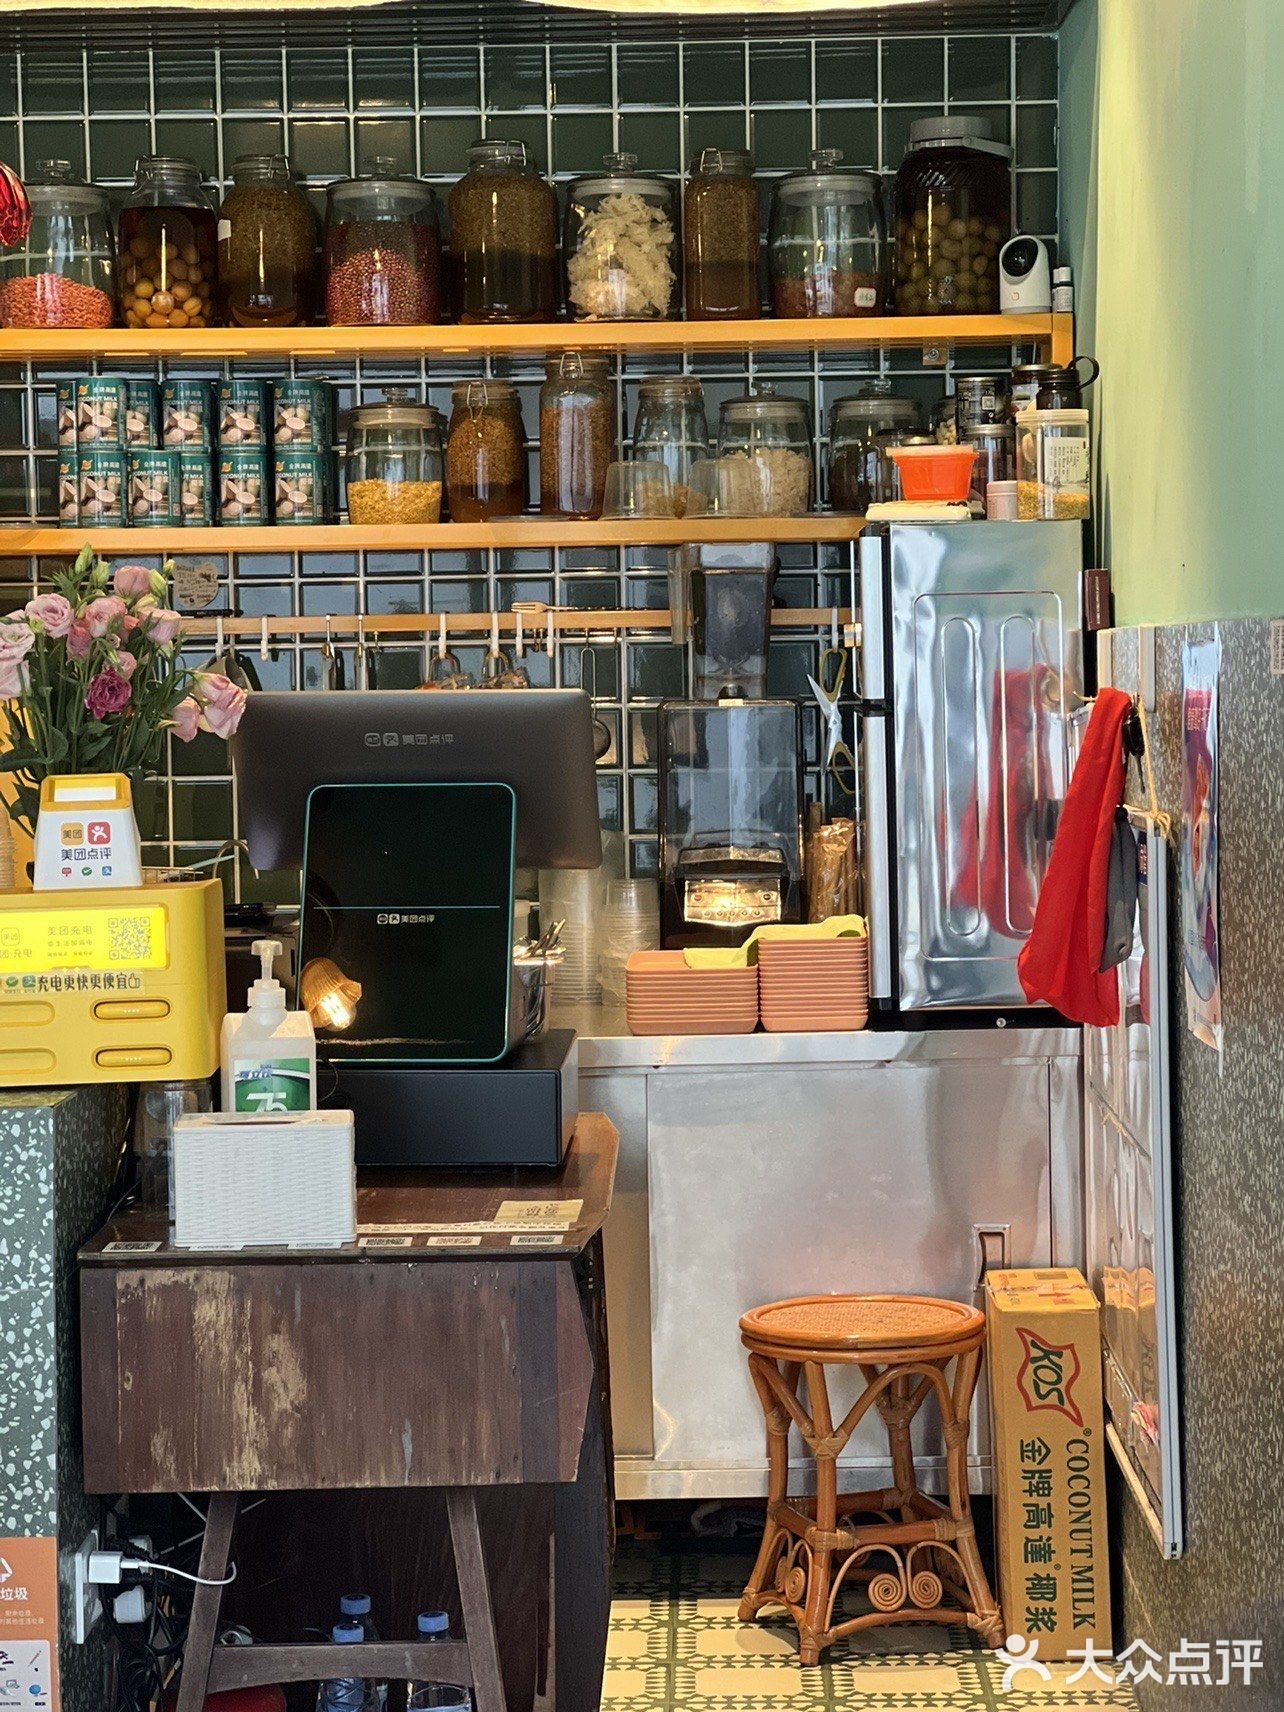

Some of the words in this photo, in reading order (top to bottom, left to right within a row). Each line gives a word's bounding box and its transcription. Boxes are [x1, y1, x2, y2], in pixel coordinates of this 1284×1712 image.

[61, 847, 112, 861] 美团点评
[48, 925, 93, 936] 美团充电
[38, 972, 128, 993] 充电更快更便宜
[1030, 1339, 1065, 1406] KOS
[1066, 1438, 1094, 1558] COCONUT
[0, 1586, 28, 1601] 垃圾
[1070, 1564, 1096, 1630] MILK
